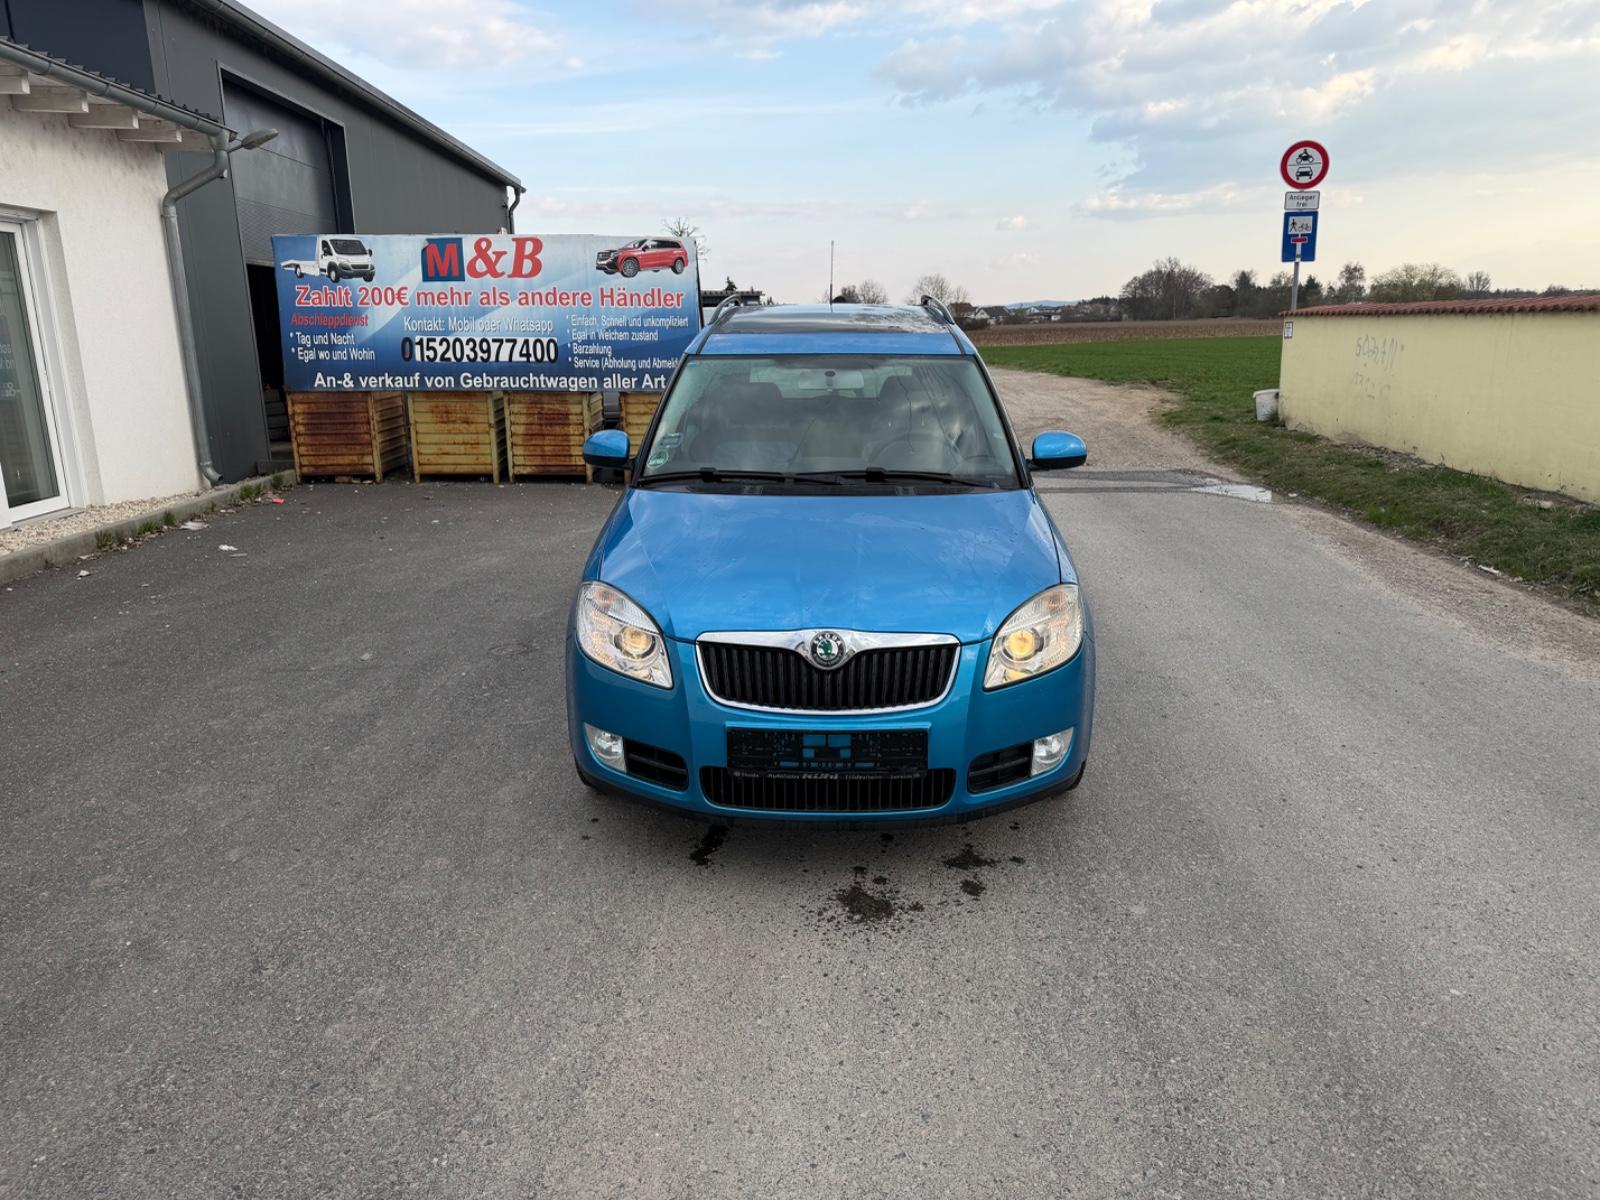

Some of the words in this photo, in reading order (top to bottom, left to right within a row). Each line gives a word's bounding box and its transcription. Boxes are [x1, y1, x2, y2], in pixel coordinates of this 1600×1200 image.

[296, 285, 352, 307] Zahlt
[358, 287, 409, 306] 200€
[415, 287, 472, 306] mehr
[479, 287, 511, 307] als
[518, 287, 592, 307] andere
[599, 287, 684, 307] Händler
[291, 313, 369, 328] Abschleppdienst
[403, 317, 445, 332] Kontakt:
[449, 317, 476, 332] Mobil
[479, 318, 501, 332] oder
[504, 317, 553, 334] Whatsapp
[601, 315, 627, 327] Schnell
[628, 315, 642, 327] und
[643, 315, 689, 329] unkompliziert
[296, 332, 311, 347] Tag
[313, 332, 328, 345] und
[330, 332, 355, 345] Nacht
[571, 329, 588, 342] Egal
[589, 330, 596, 340] in
[598, 330, 630, 340] Welchem
[631, 330, 659, 341] zustand
[297, 347, 316, 362] Egal
[318, 350, 331, 360] wo
[332, 348, 347, 360] und
[349, 347, 376, 360] Wohin
[401, 336, 559, 363] 015203977400
[572, 342, 613, 356] Barzahlung
[574, 357, 600, 369] Service
[601, 357, 637, 371] (Abholung
[638, 358, 651, 369] und
[652, 358, 681, 369] Abmeld
[314, 372, 355, 388] An-&
[359, 372, 420, 388] verkauf
[424, 376, 455, 388] von
[459, 373, 598, 392] Gebrauchtwagen
[603, 373, 638, 389] aller
[641, 374, 667, 389] Art
